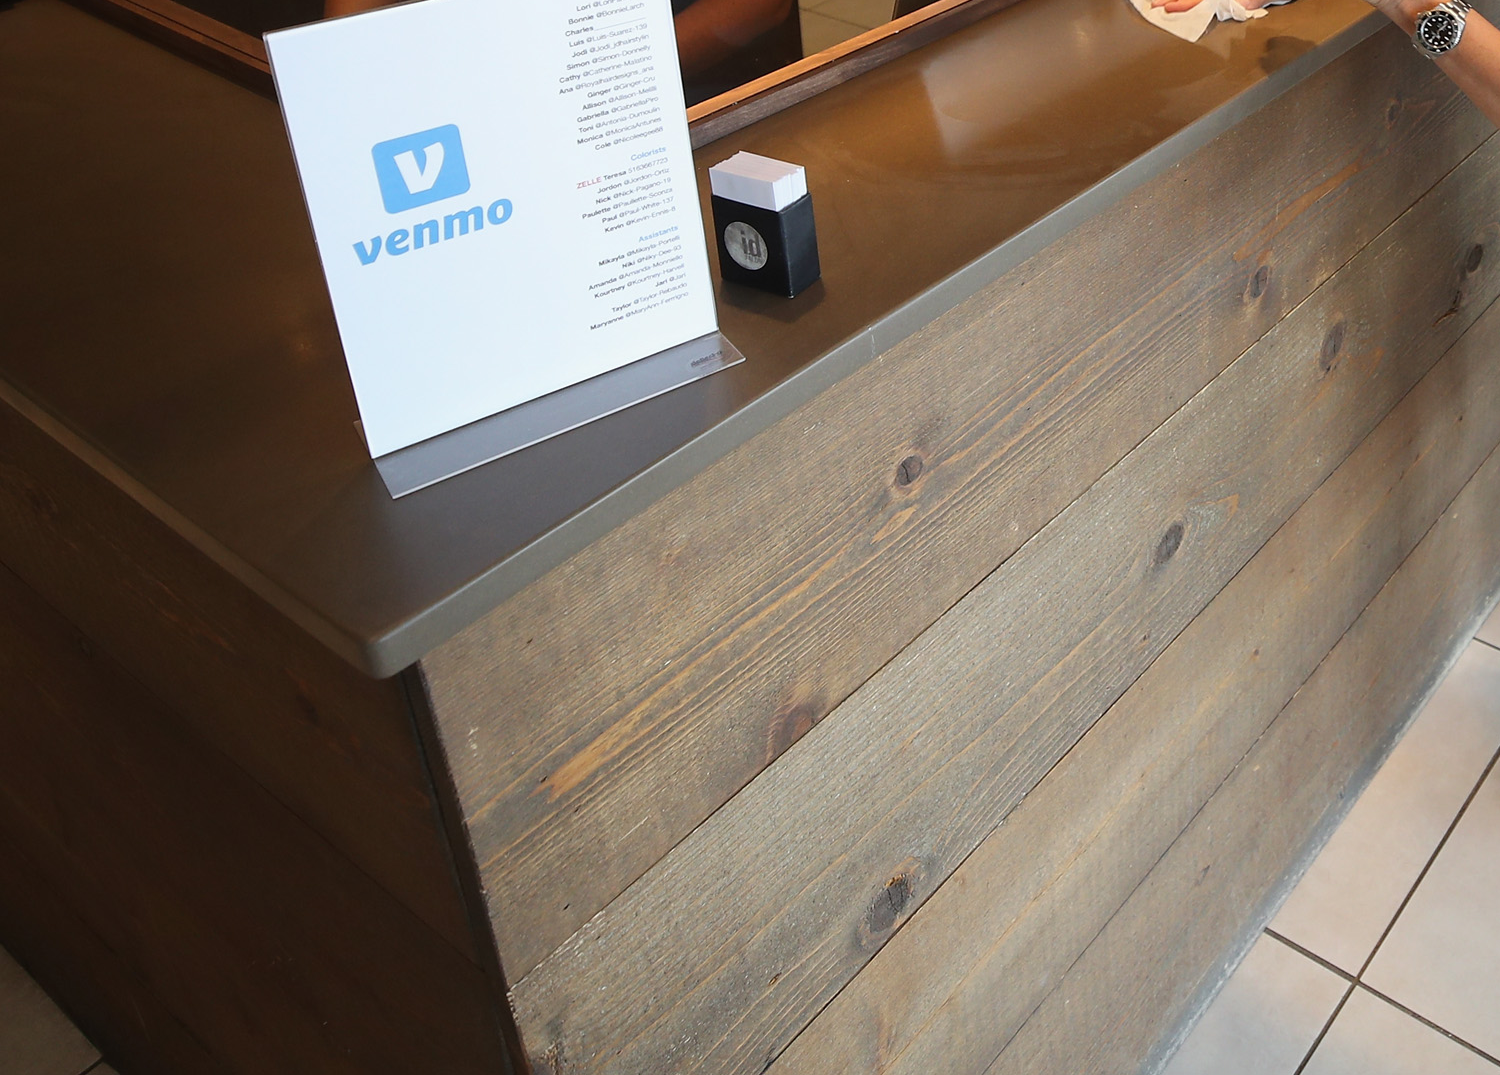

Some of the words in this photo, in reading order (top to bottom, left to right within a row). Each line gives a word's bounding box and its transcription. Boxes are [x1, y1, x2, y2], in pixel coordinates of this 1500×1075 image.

[576, 3, 592, 12] Lori
[568, 14, 594, 25] Bonnie
[569, 39, 584, 48] Luis
[572, 49, 588, 58] Jodi
[566, 60, 590, 70] Simon
[559, 73, 581, 84] Cathy
[559, 86, 574, 95] Ana
[587, 87, 612, 98] Ginger
[582, 99, 607, 111] Allison
[577, 109, 609, 123] Gabriella
[578, 124, 594, 134] Toni
[577, 133, 604, 145] Monica
[595, 142, 612, 151] Cole
[630, 146, 667, 162] Colorists
[576, 176, 602, 189] ZELLE
[603, 170, 627, 181] Teresa
[597, 182, 622, 194] Jordon
[595, 196, 611, 205] Nick
[582, 206, 611, 220] Paulette
[602, 214, 618, 224] Paul
[352, 198, 514, 266] venmo
[604, 222, 624, 233] Kevin
[638, 225, 679, 243] Assistants
[598, 254, 625, 267] Mikayla
[588, 277, 617, 291] Amanda
[594, 283, 626, 299] Kourtney
[612, 302, 632, 313] Taylor
[590, 314, 624, 331] Maryanne
